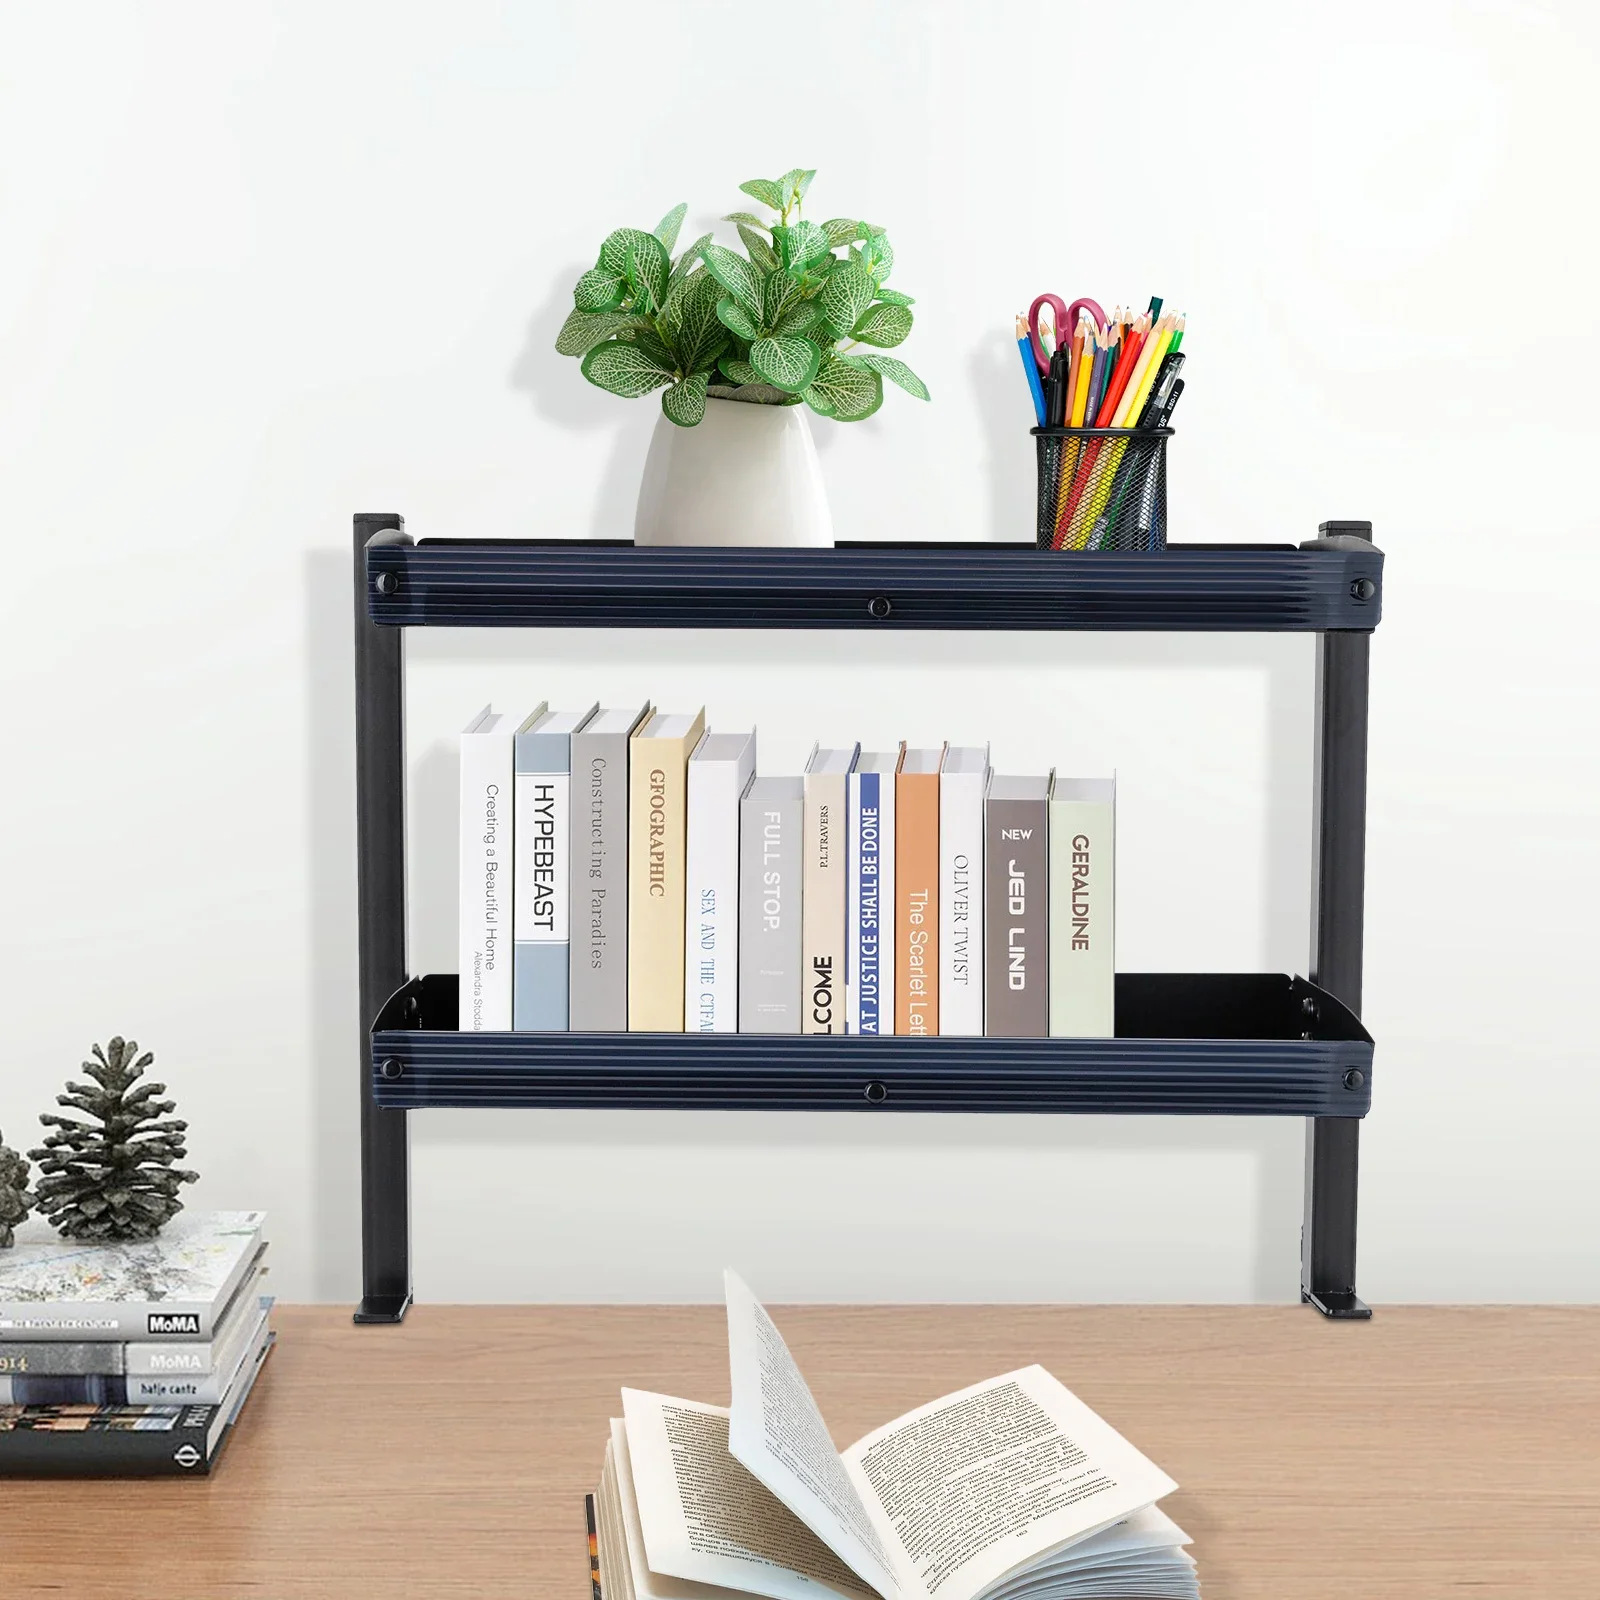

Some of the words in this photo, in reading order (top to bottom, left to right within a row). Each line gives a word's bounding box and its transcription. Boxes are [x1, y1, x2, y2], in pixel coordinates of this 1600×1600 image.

[483, 784, 499, 845] Creating
[590, 757, 607, 879] Constructing
[862, 806, 877, 851] DONE
[1001, 828, 1033, 841] NEW
[487, 848, 497, 857] a
[534, 784, 554, 931] HYPEBEAST
[763, 811, 781, 866] FULL
[862, 854, 877, 876] BE
[1008, 859, 1025, 916] JED
[486, 861, 498, 924] Beautiful
[701, 889, 715, 916] SEX
[763, 871, 780, 932] STOP.
[862, 878, 877, 929] SHALL
[909, 888, 928, 925] The
[953, 854, 969, 924] OLIVER
[1071, 834, 1090, 951] GERALDINE
[484, 929, 497, 971] Home
[591, 888, 606, 969] Paradies
[701, 923, 715, 951] AND
[473, 950, 483, 996] Alexandra
[700, 959, 715, 986] THE
[861, 934, 877, 1004] JUSTICE
[909, 930, 928, 997] Scarlet
[953, 928, 969, 986] TWIST
[1008, 927, 1025, 991] LIND
[473, 999, 482, 1031] Stodda
[861, 1010, 878, 1033] AT
[150, 1316, 198, 1332] MoMA
[150, 1355, 202, 1369] MoMA
[141, 1383, 166, 1395] hatje
[989, 1536, 999, 1545] на
[1033, 1505, 1060, 1521] Масло
[1016, 1529, 1028, 1539] 163
